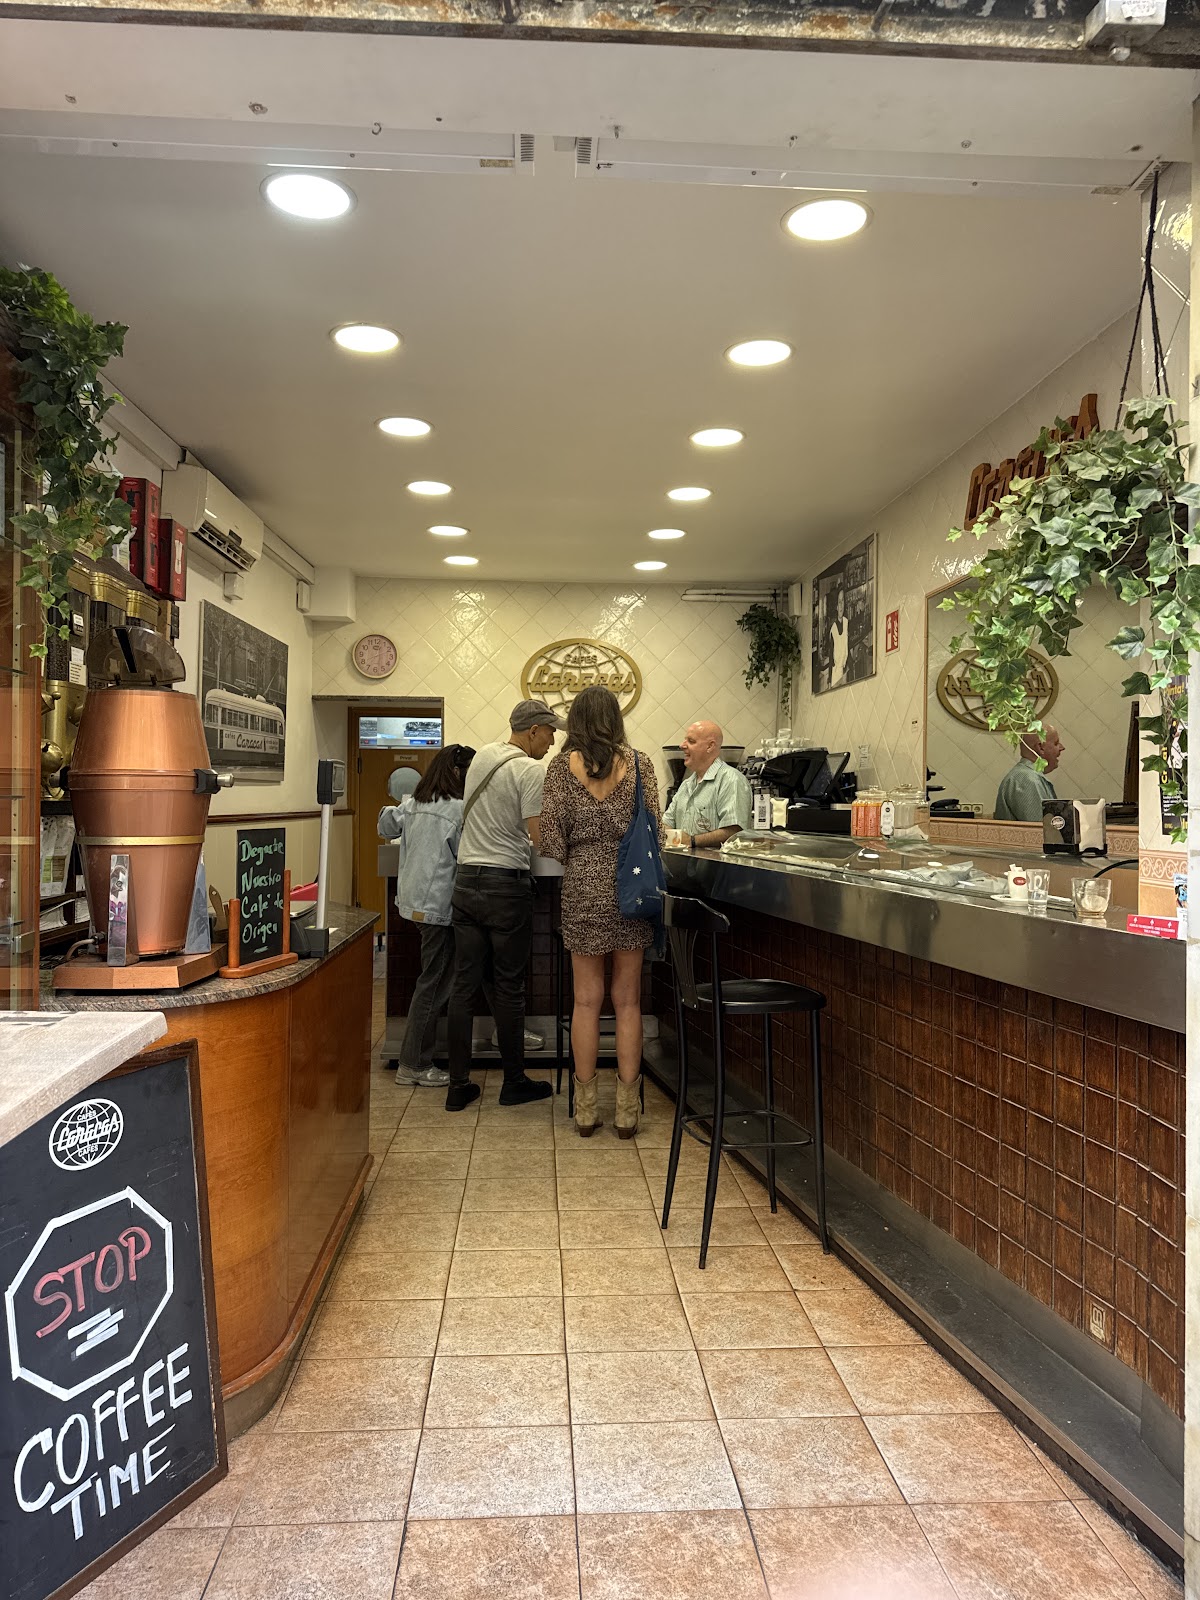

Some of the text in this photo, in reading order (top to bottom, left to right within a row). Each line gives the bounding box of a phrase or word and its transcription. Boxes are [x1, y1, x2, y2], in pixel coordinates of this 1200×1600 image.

[241, 866, 282, 895] Nuestro
[241, 891, 284, 919] Café de
[242, 921, 278, 944] Origen
[33, 1226, 152, 1339] STOP
[14, 1342, 193, 1513] COFFEE
[50, 1423, 176, 1541] TIME
